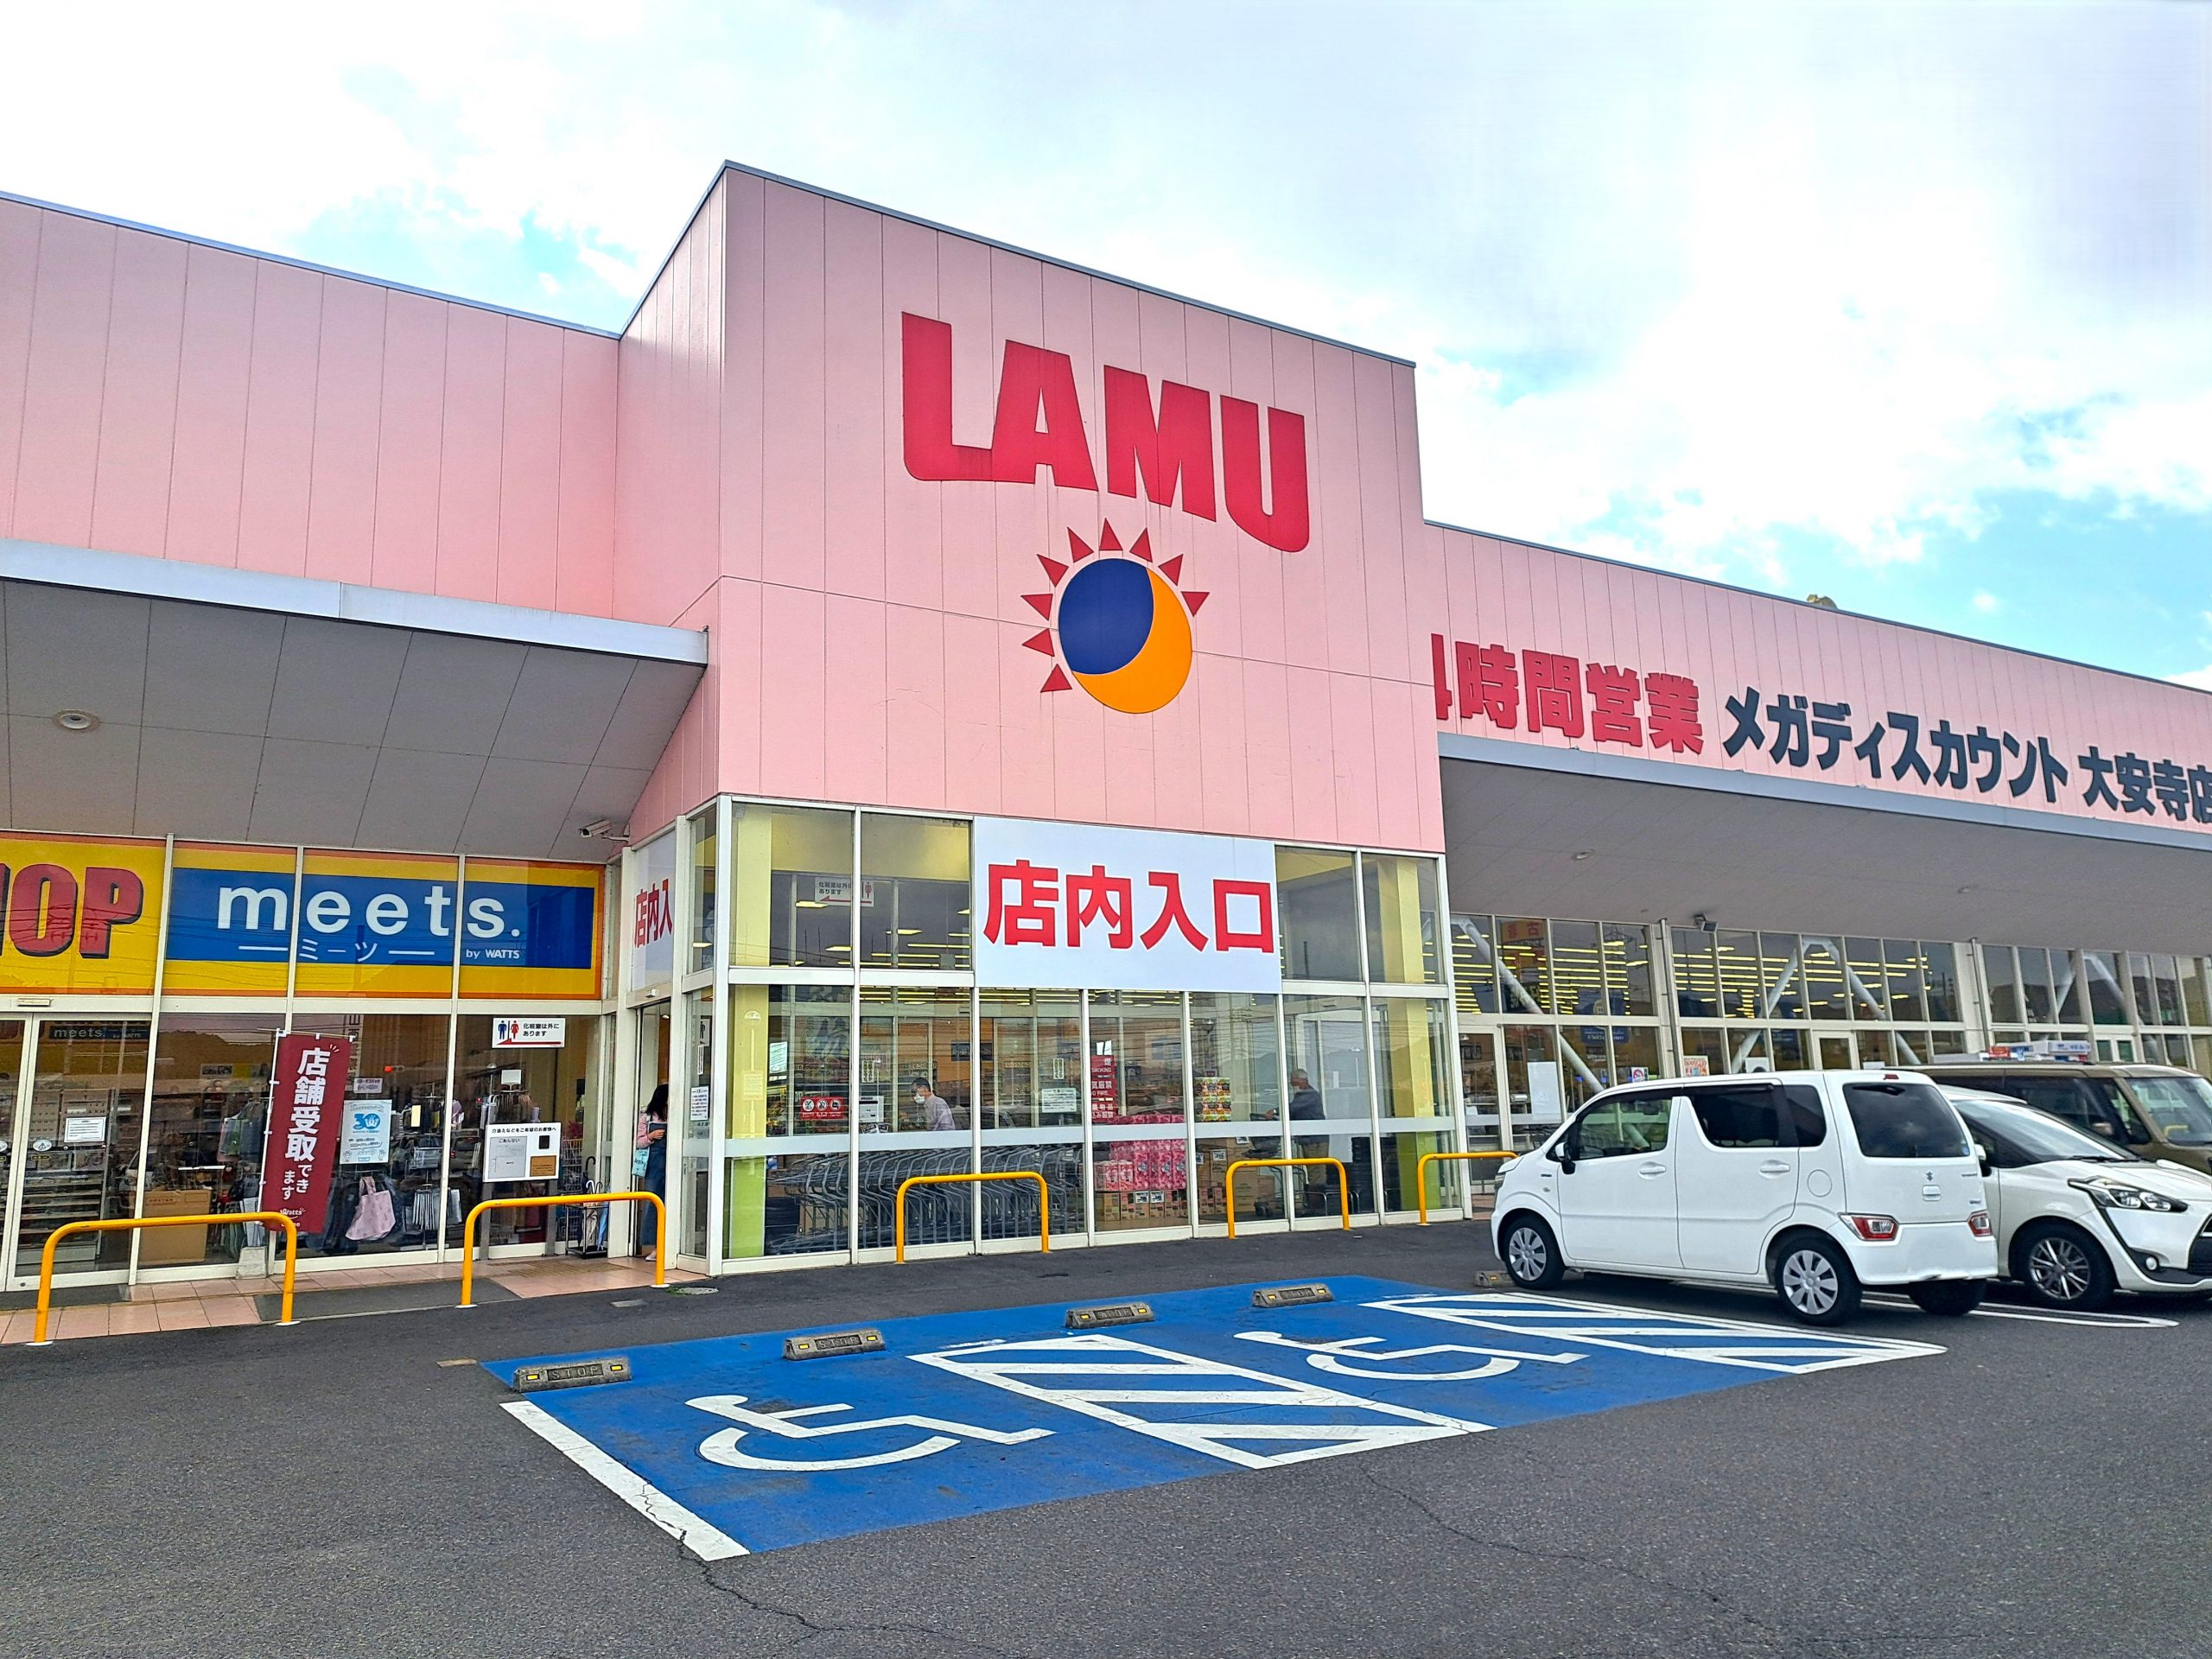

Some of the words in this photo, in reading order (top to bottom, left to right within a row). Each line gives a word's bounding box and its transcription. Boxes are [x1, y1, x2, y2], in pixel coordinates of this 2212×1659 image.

[902, 312, 1309, 552] LAMU
[1723, 686, 2068, 804] メガディスカウント
[2078, 746, 2212, 823] 大安寺店
[0, 863, 143, 959] OP
[466, 949, 480, 959] by
[486, 949, 520, 960] WATTS
[983, 860, 1274, 955] 店内入口
[285, 1047, 331, 1162] 店舗受取
[817, 1336, 861, 1349] STOP
[1096, 1308, 1131, 1319] STOP
[550, 1364, 599, 1380] STOP
